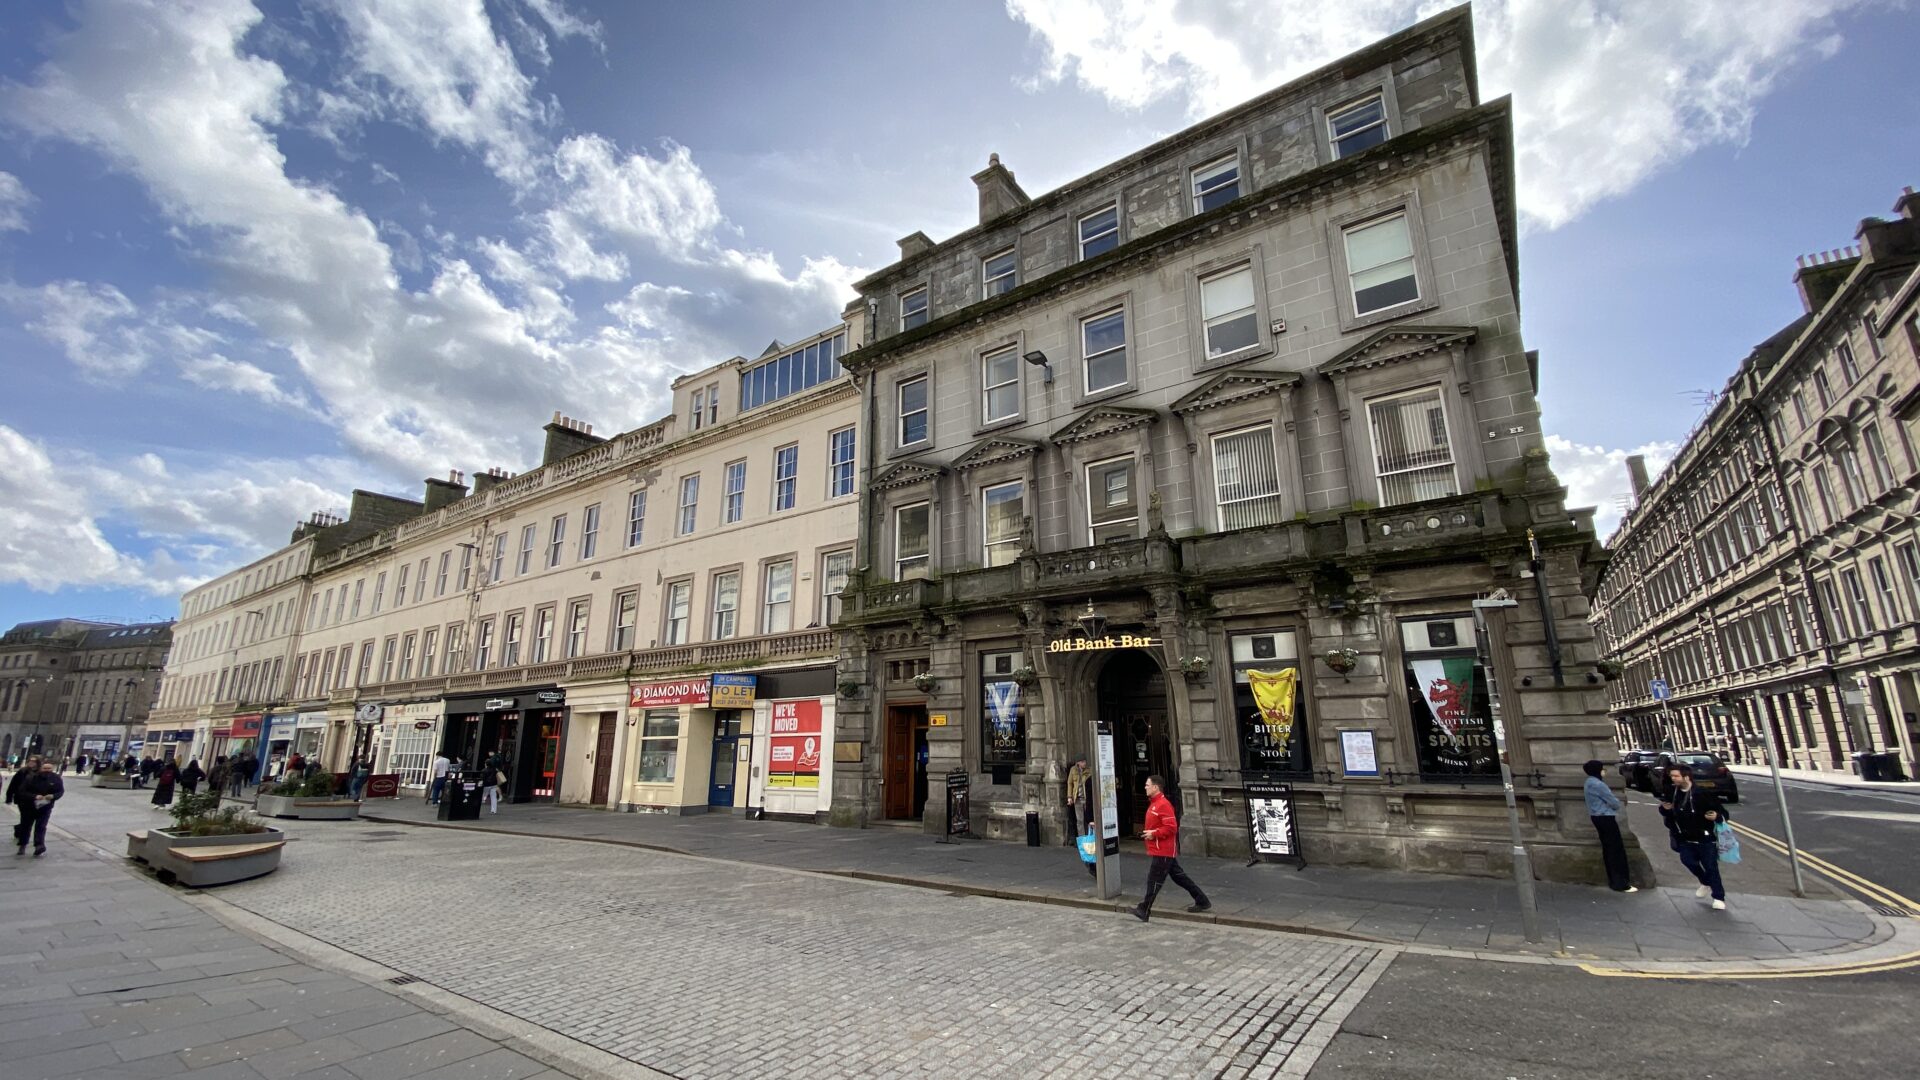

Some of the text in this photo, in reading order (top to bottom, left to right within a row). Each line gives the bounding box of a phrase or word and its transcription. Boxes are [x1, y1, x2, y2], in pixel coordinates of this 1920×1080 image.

[1050, 635, 1152, 652] Old Bank Bar
[643, 685, 690, 698] DIAMOND
[714, 686, 754, 696] TO LET
[775, 704, 796, 717] WE'VE
[774, 718, 798, 731] MOVED
[1254, 725, 1291, 733] BITTER
[1264, 736, 1287, 747] IPA
[1429, 734, 1491, 747] SPIRITS
[1437, 756, 1491, 766] WHISKY GIN
